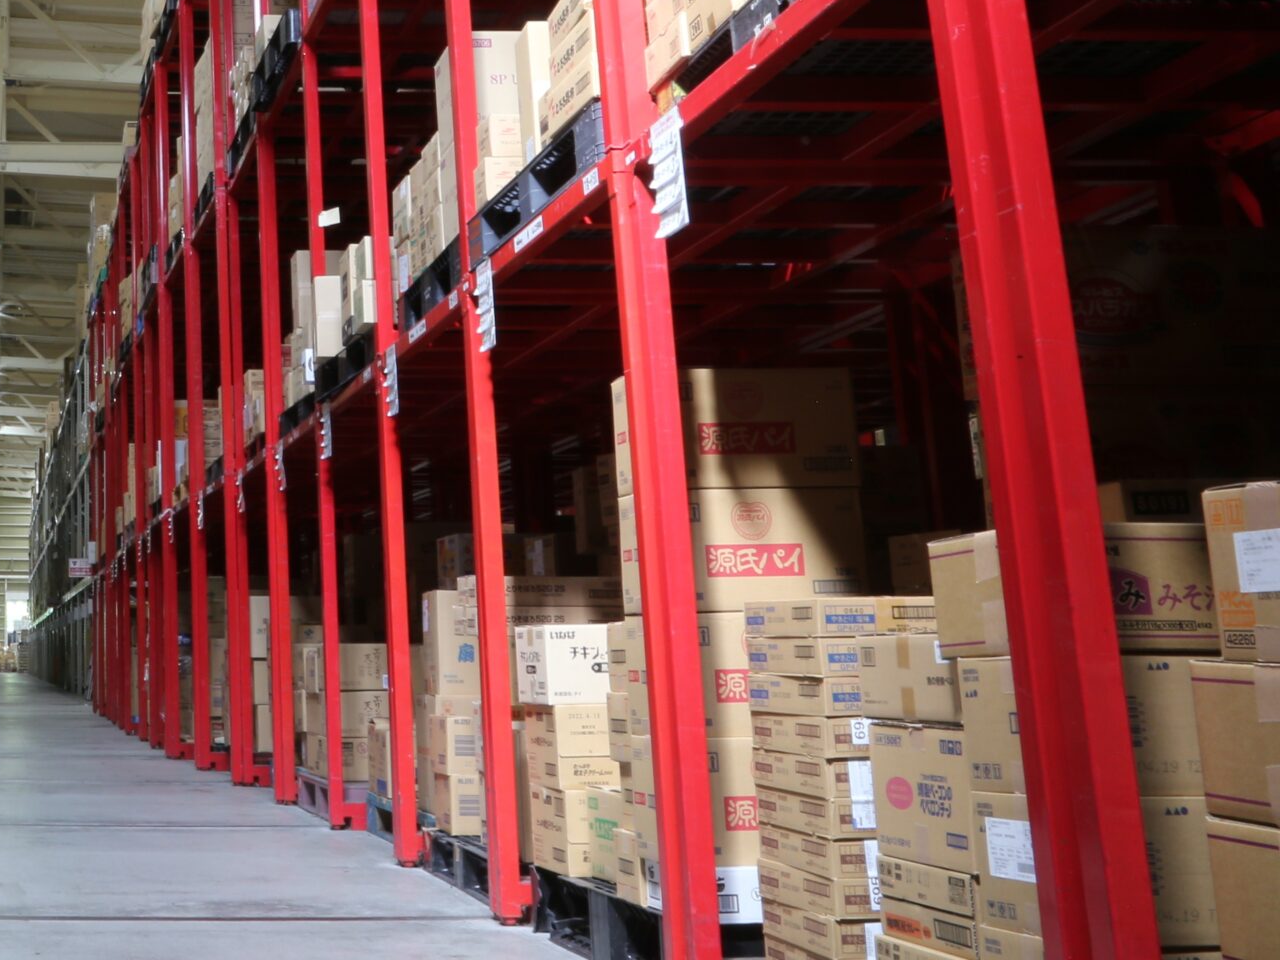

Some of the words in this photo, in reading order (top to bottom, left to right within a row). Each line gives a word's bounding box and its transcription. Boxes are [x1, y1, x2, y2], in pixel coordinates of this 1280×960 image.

[701, 425, 792, 452] 源氏パイ
[709, 547, 802, 575] 源氏パイ
[549, 630, 576, 640] いなば
